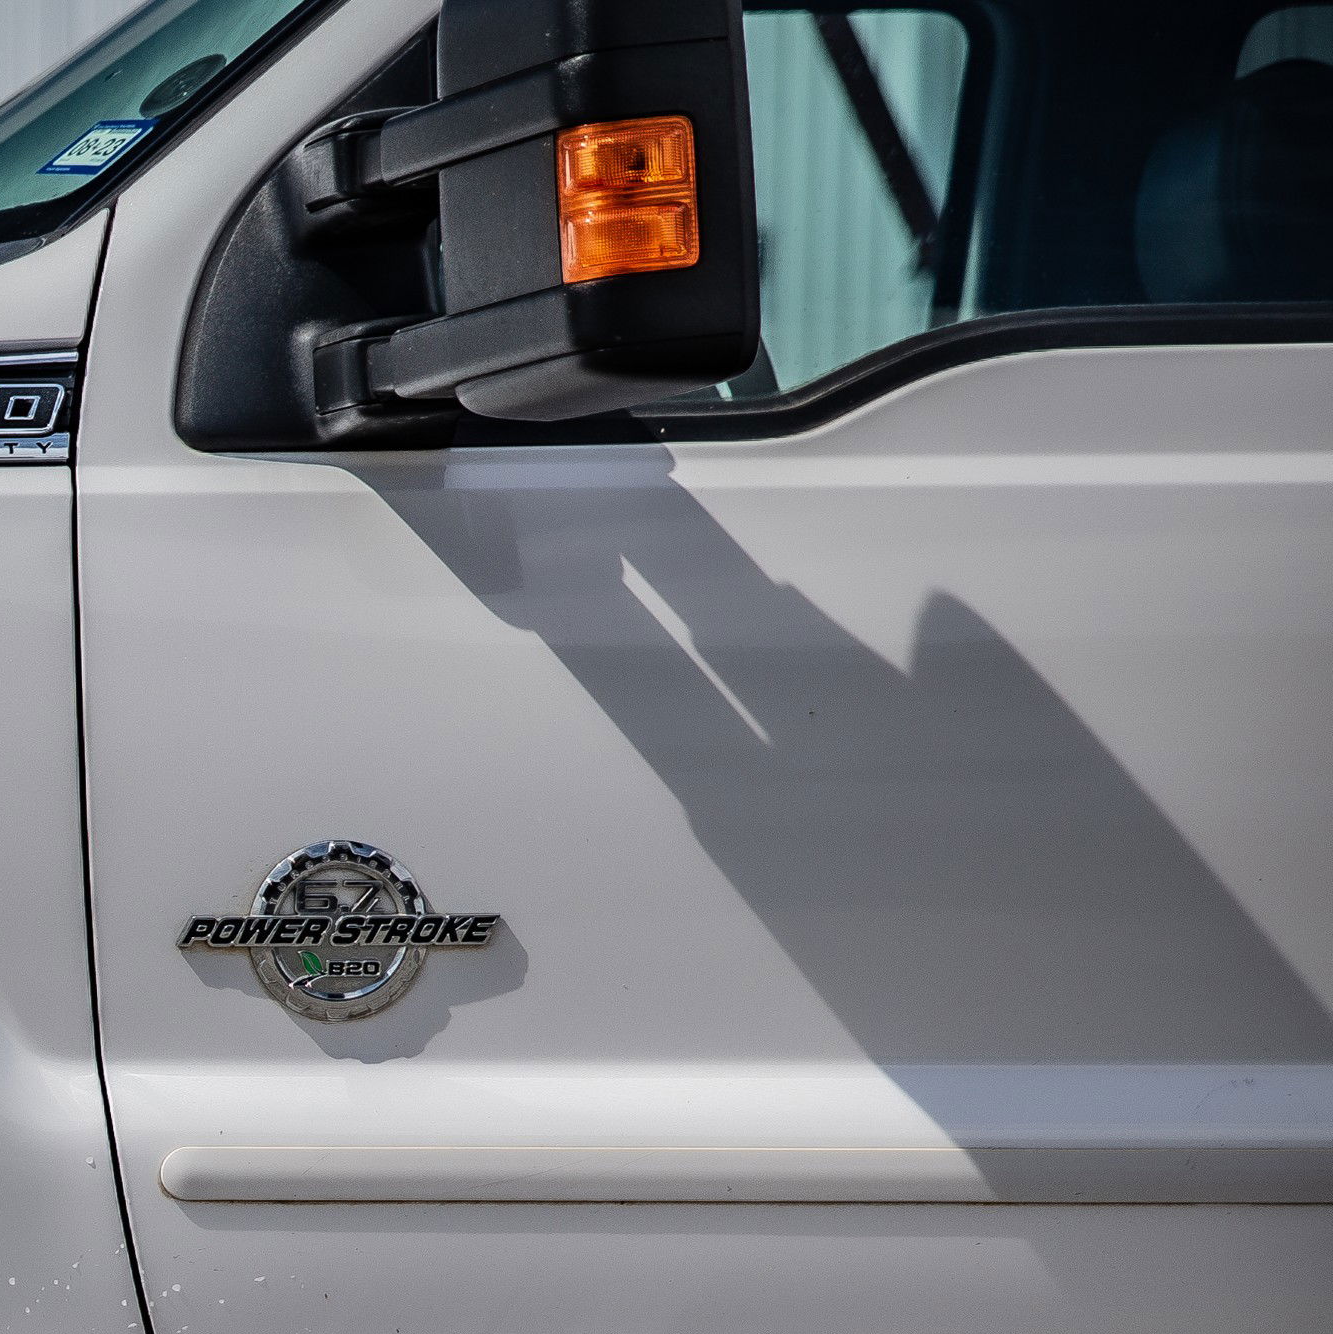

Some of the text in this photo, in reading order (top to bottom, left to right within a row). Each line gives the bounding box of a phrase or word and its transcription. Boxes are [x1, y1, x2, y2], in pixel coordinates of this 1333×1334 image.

[177, 913, 501, 947] POWER STROKE
[326, 960, 382, 977] B20
